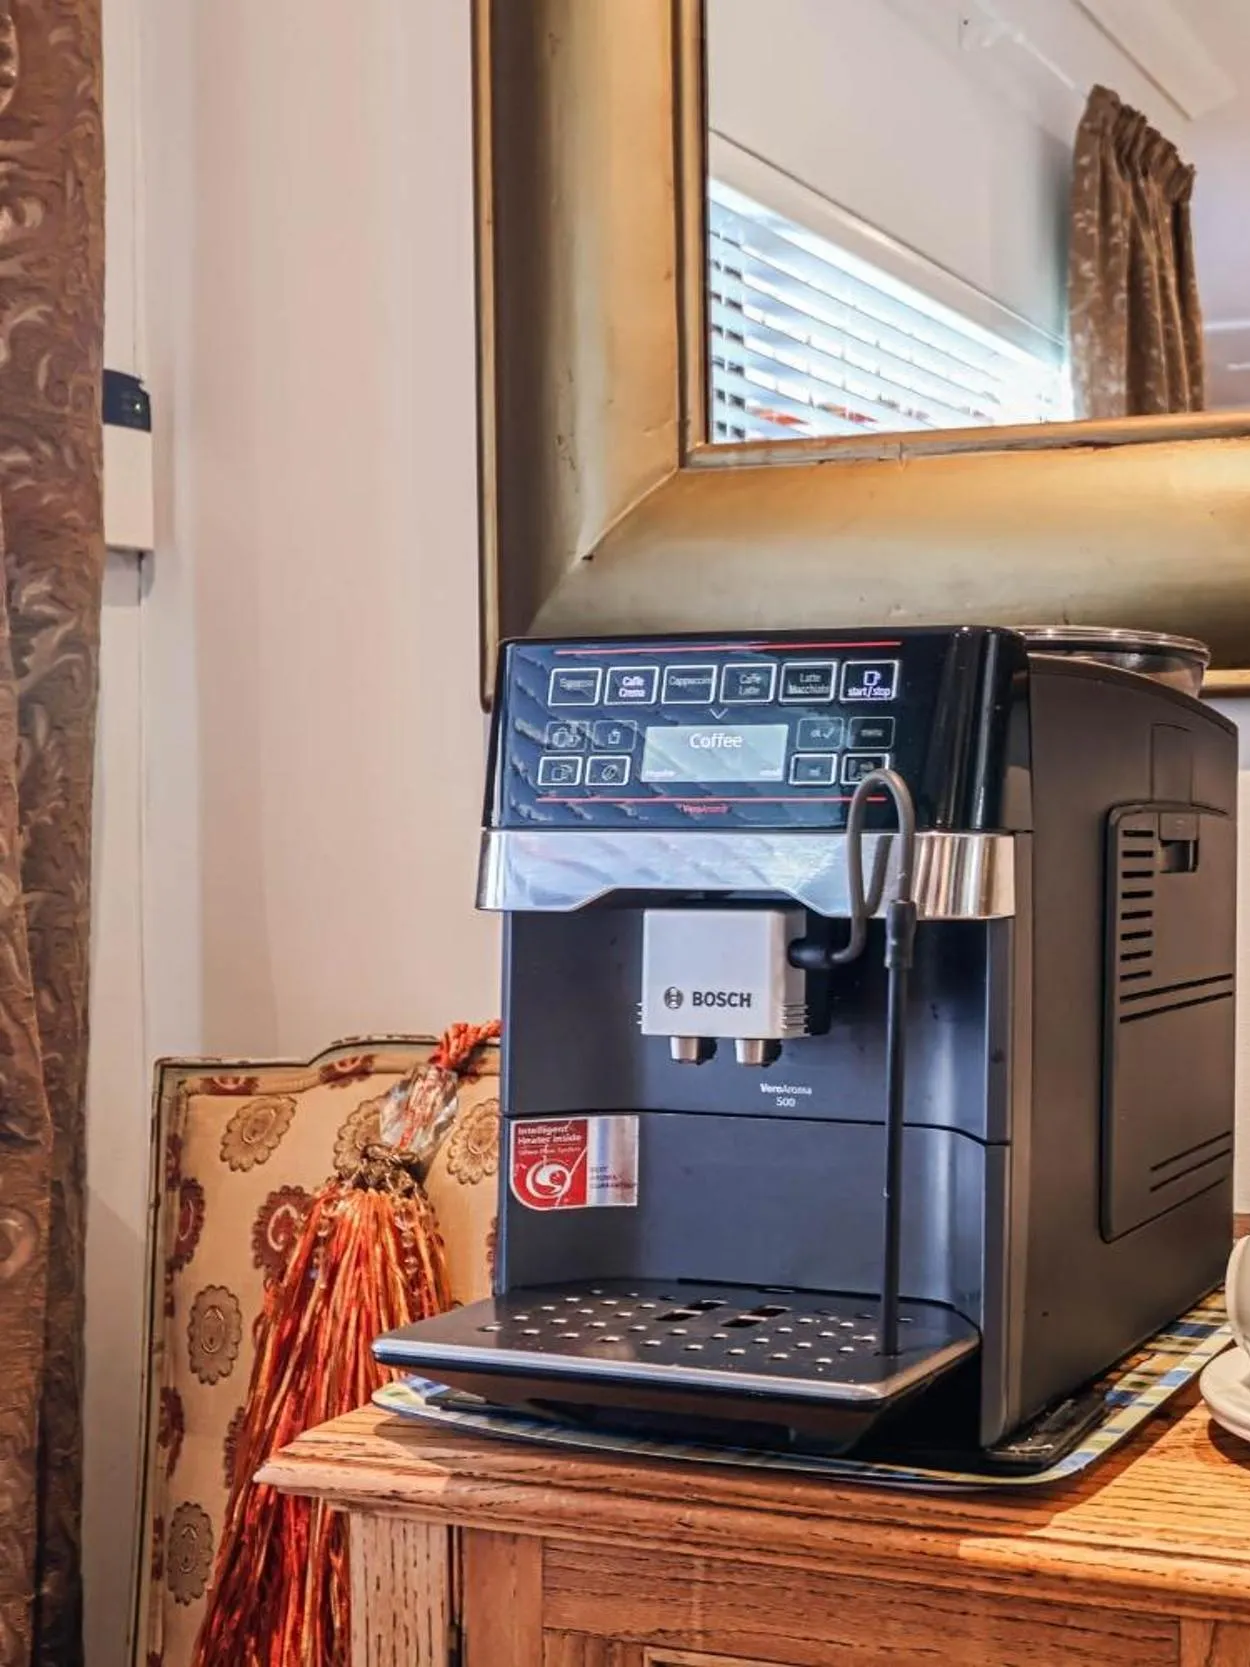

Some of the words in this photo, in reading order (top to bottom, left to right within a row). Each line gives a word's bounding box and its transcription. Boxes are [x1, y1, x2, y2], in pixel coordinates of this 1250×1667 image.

[689, 732, 744, 749] Coffee
[692, 991, 752, 1008] BOSCH
[776, 1096, 796, 1107] 500
